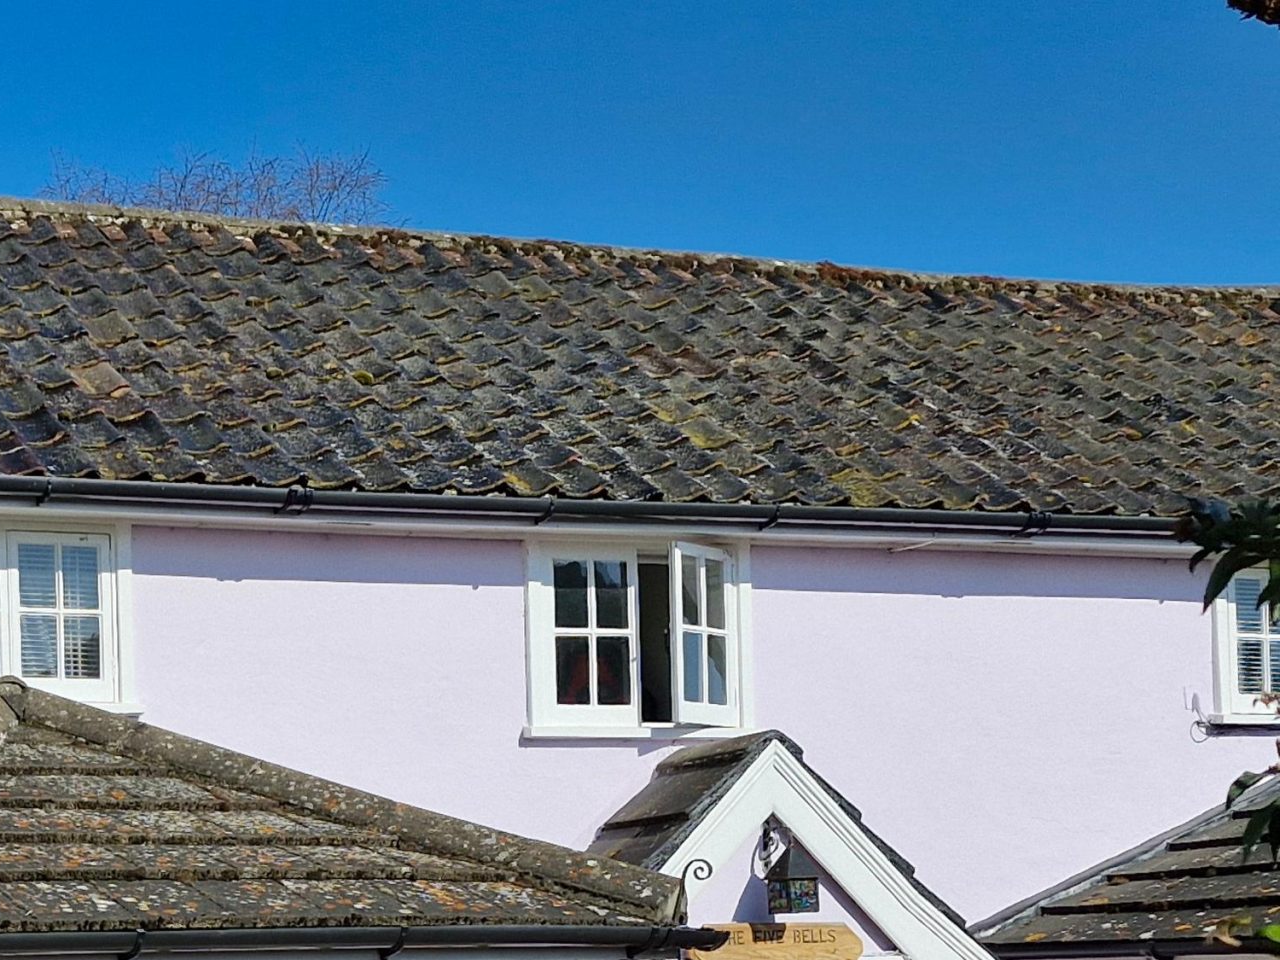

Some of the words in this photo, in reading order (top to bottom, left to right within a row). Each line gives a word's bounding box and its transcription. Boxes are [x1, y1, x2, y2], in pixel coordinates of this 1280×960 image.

[727, 930, 745, 945] HE
[754, 930, 785, 944] FIVE
[793, 929, 837, 944] BELLS
